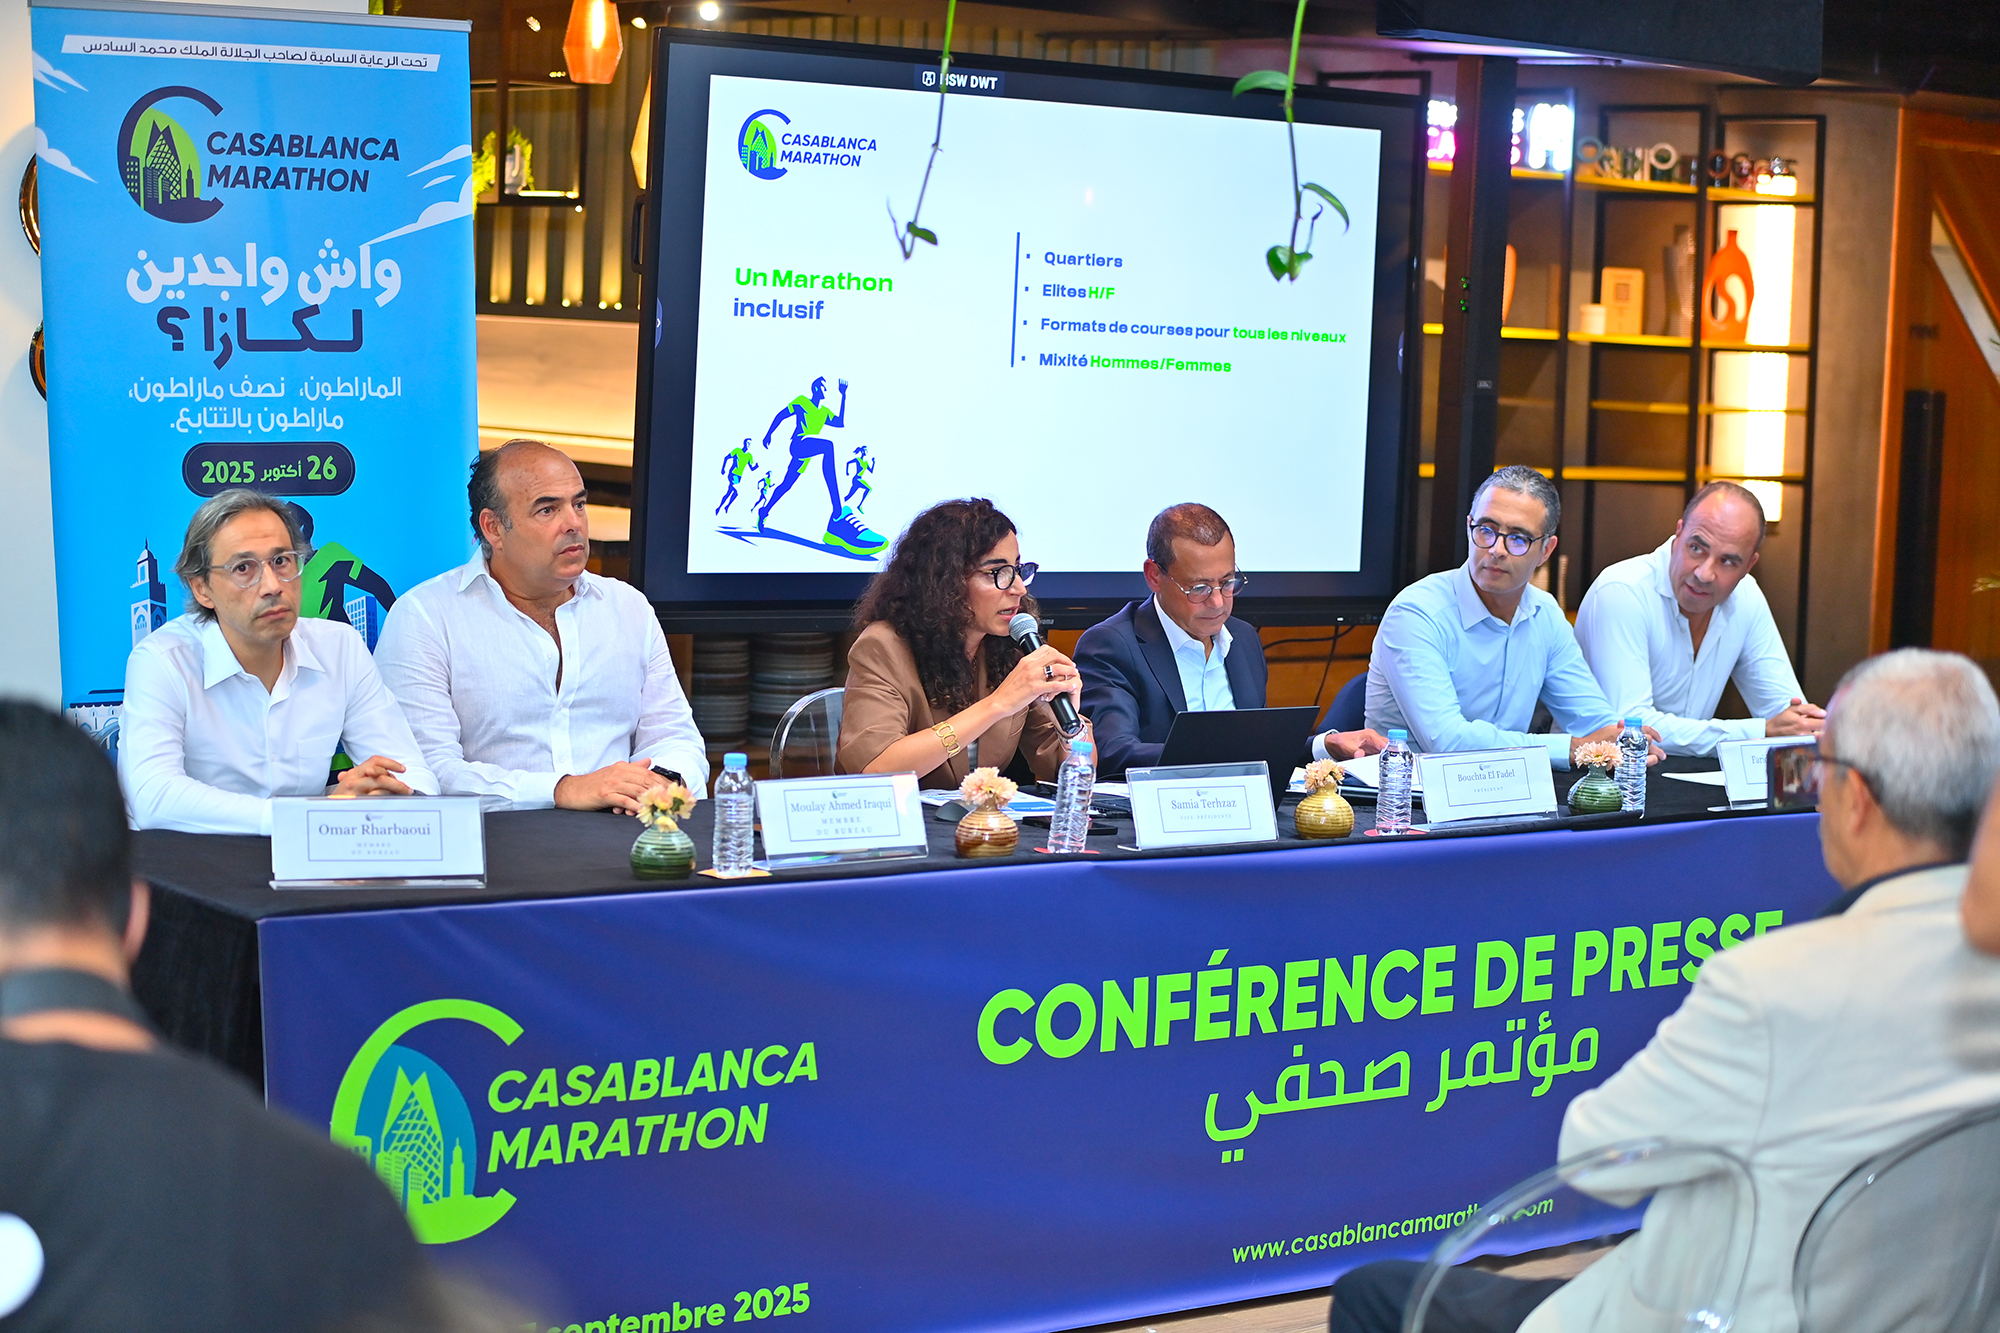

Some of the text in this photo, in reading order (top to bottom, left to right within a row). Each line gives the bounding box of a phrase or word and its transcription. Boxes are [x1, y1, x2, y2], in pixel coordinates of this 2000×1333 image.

[82, 41, 428, 69] تحت الرعاية السامية لصاحب الجلالة الملك محمد السادس
[970, 75, 998, 90] DWT
[206, 131, 400, 162] CASABLANCA
[781, 132, 877, 151] CASABLANCA
[780, 150, 862, 167] MARATHON
[206, 164, 370, 192] MARATHON
[1044, 251, 1123, 268] Quartiers
[126, 238, 402, 307] واش واجدين
[734, 267, 894, 292] Un Marathon
[1042, 284, 1115, 299] Elites H/F
[733, 298, 824, 320] inclusif
[1041, 318, 1347, 343] Formats de courses pour tous les niveaux
[1039, 353, 1232, 372] Mixité Hommes/Femmes
[128, 375, 402, 402] الماراطون، نصف ماراطون،
[257, 406, 344, 432] ماراطون
[201, 455, 337, 483] 26 أكتوبر 2025
[1457, 769, 1515, 782] Bouchta El Fadel
[790, 797, 892, 814] Moulay Ahmed Iraqui
[1171, 797, 1237, 810] Samia Terhzaz
[318, 822, 431, 836] Omar Rharbaoui
[821, 816, 862, 825] MEMBRE
[976, 945, 1457, 1065] CONFÉRENCE
[1473, 935, 1554, 1009] DE
[486, 1042, 819, 1113] CASABLANCA
[1204, 1010, 1600, 1163] مؤتمر صحفي
[486, 1103, 769, 1173] MARATHON
[733, 1282, 811, 1323] 2025
